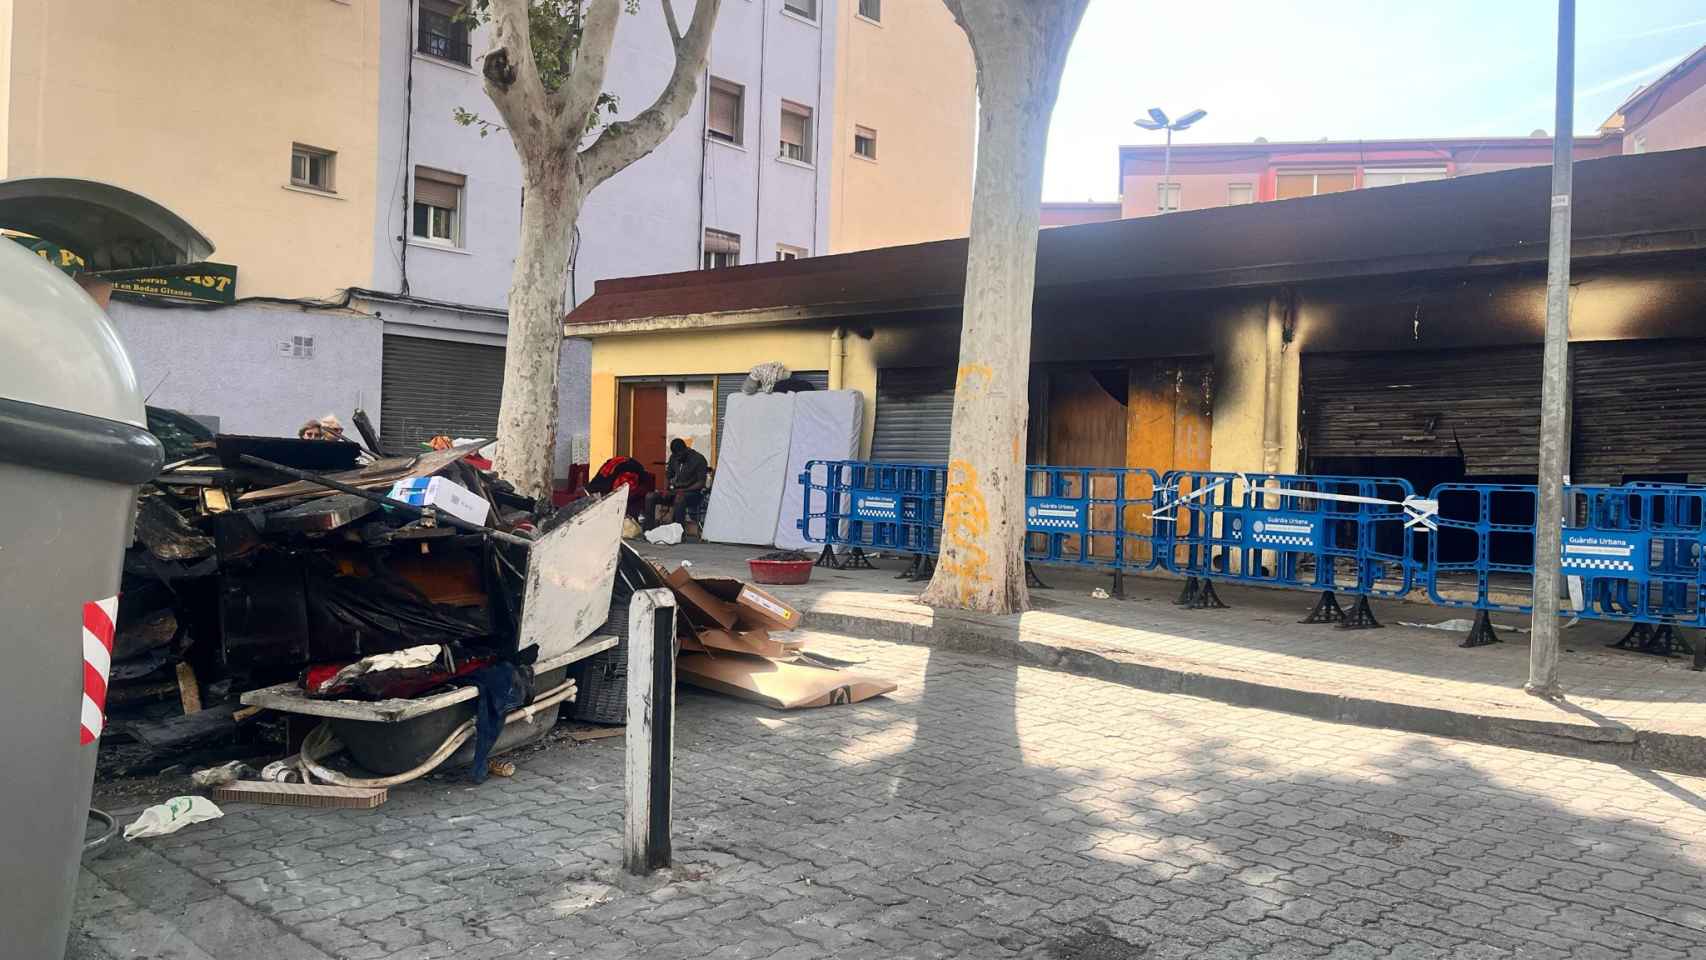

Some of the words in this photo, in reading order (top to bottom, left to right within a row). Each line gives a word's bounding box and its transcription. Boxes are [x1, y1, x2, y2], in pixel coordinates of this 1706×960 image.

[133, 283, 159, 293] Bodas
[160, 287, 193, 297] Gitanas
[1599, 537, 1627, 546] Urbana
